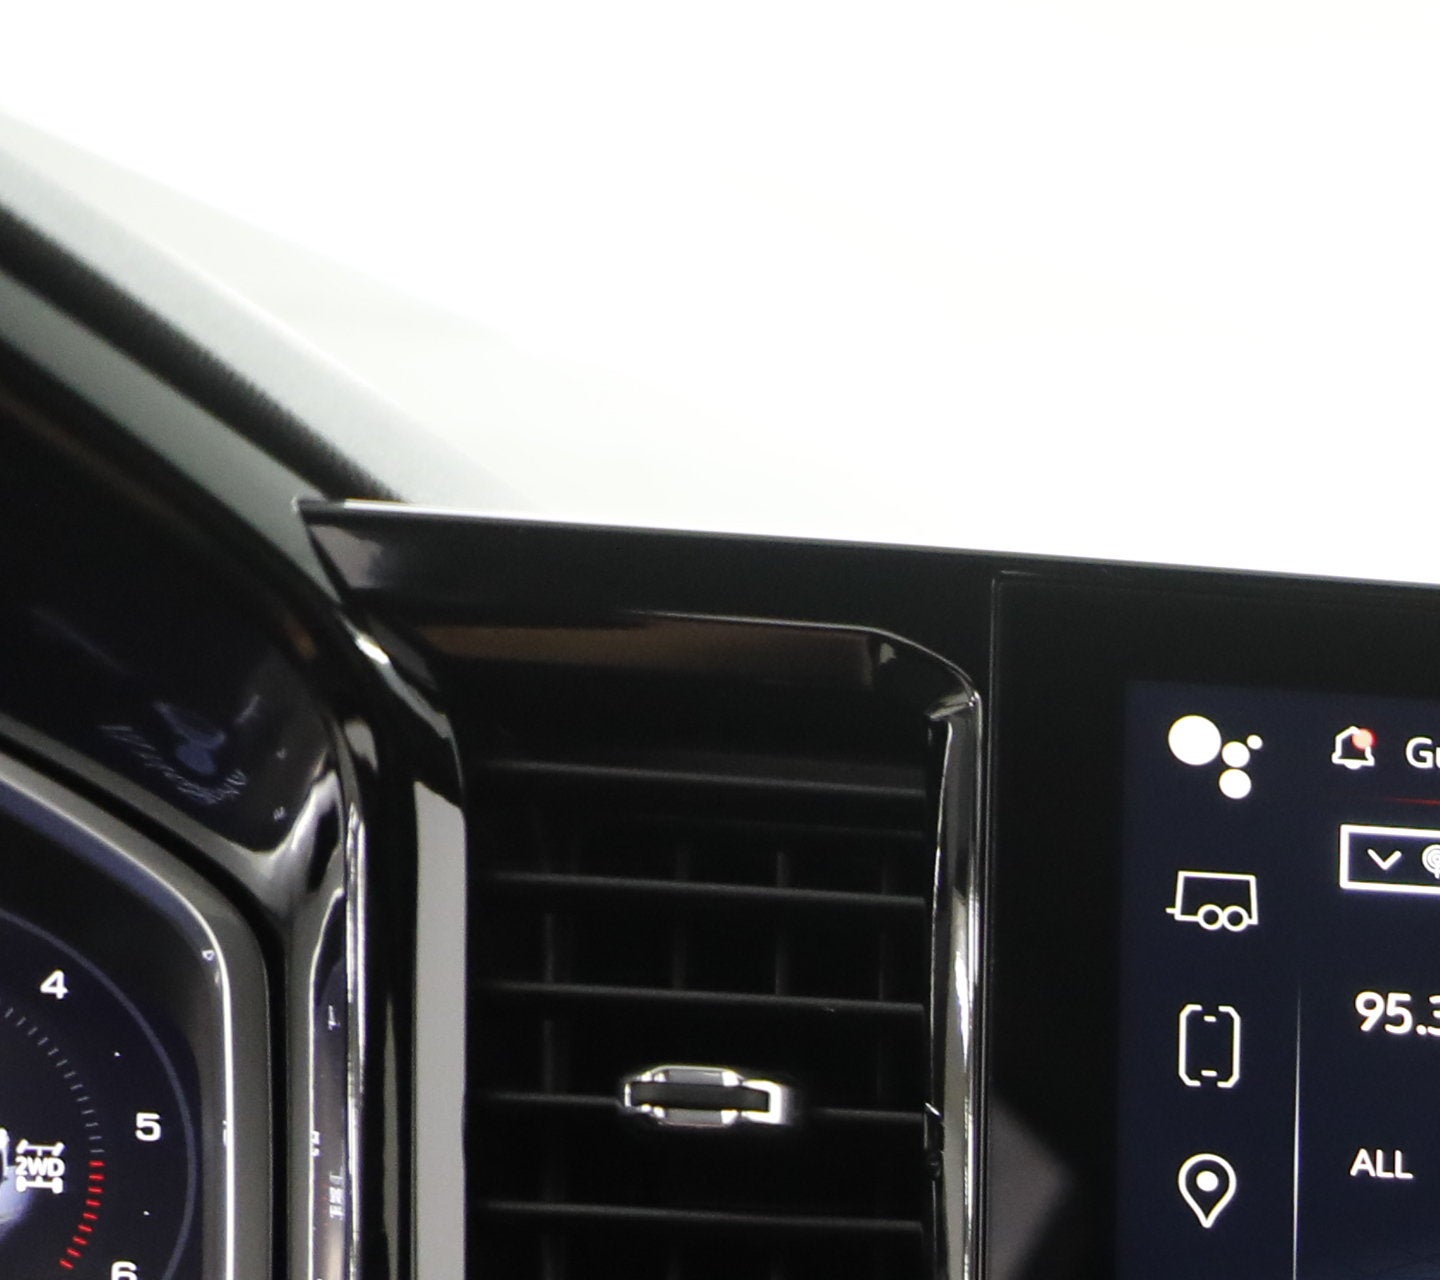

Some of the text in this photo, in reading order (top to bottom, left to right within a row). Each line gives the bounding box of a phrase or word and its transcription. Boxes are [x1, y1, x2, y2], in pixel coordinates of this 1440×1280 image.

[40, 970, 68, 999] 4
[136, 1113, 161, 1141] 5
[15, 1157, 65, 1179] 2WD
[1350, 1149, 1413, 1179] ALL
